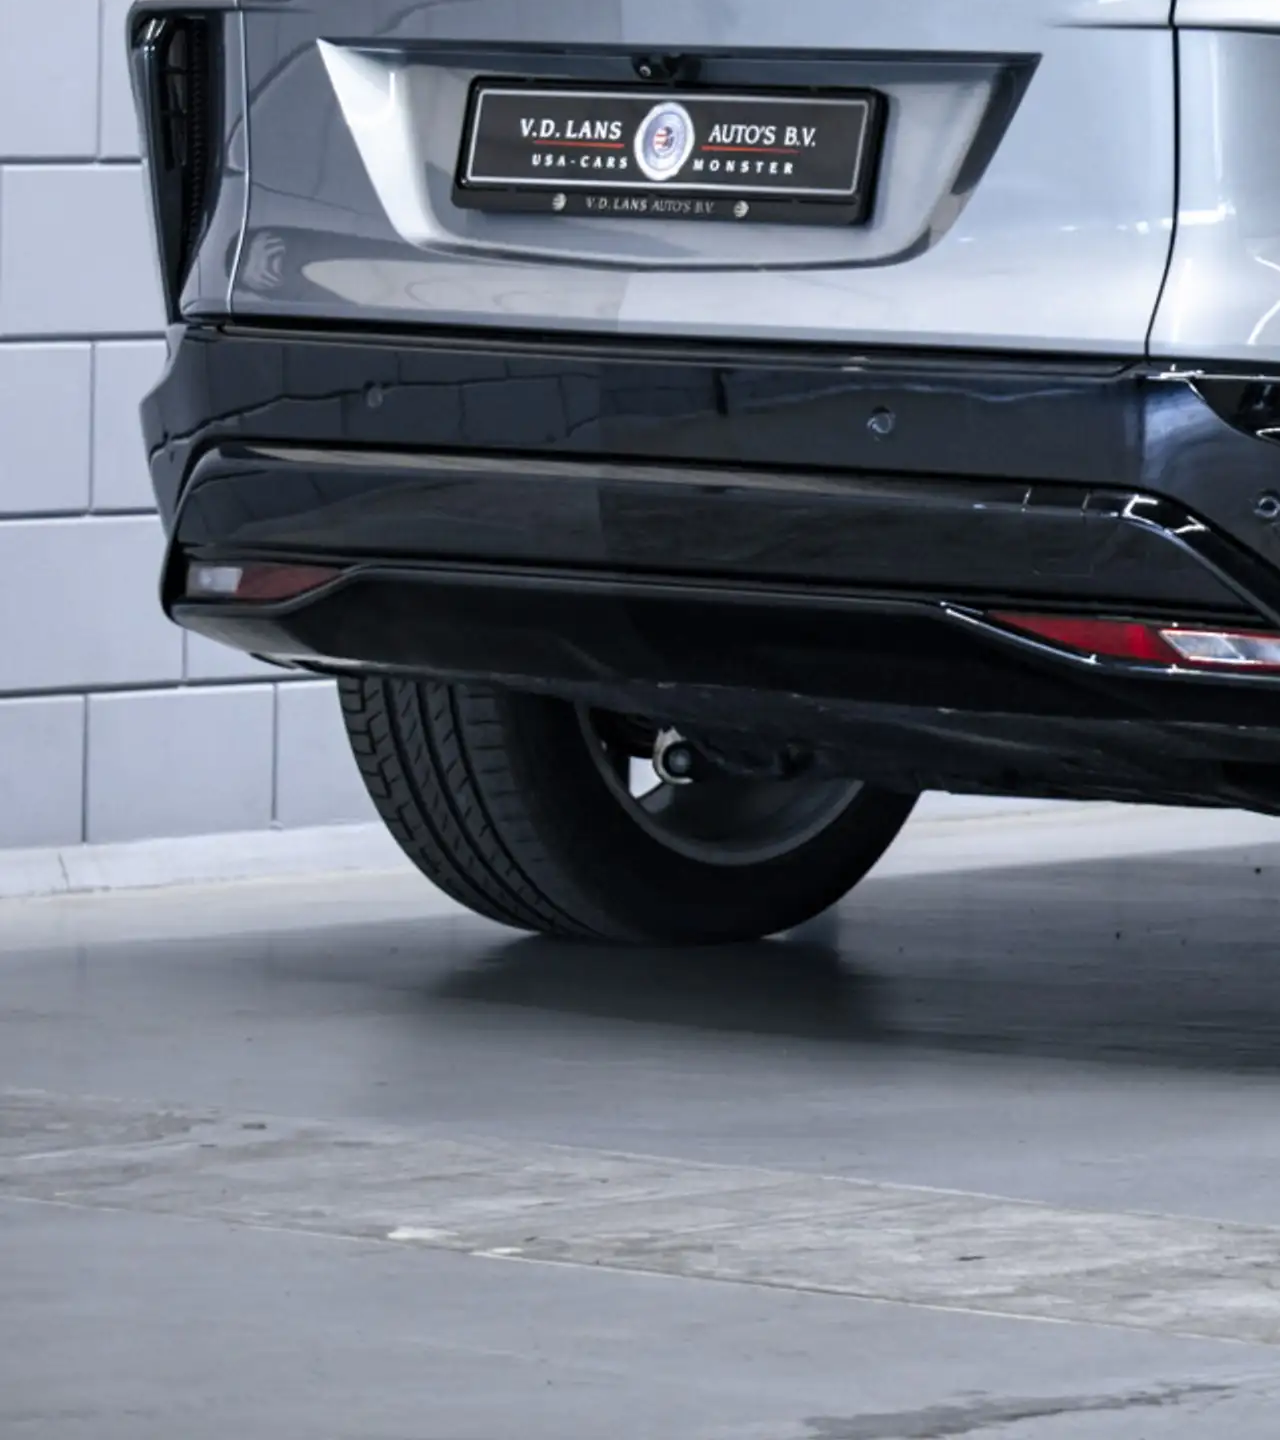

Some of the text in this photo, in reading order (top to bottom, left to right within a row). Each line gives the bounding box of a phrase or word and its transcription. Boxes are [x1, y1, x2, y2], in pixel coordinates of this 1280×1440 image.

[520, 118, 816, 147] V.D. LANS AUTO'S B.V.
[692, 158, 794, 175] MONSTER
[613, 197, 648, 211] LANS
